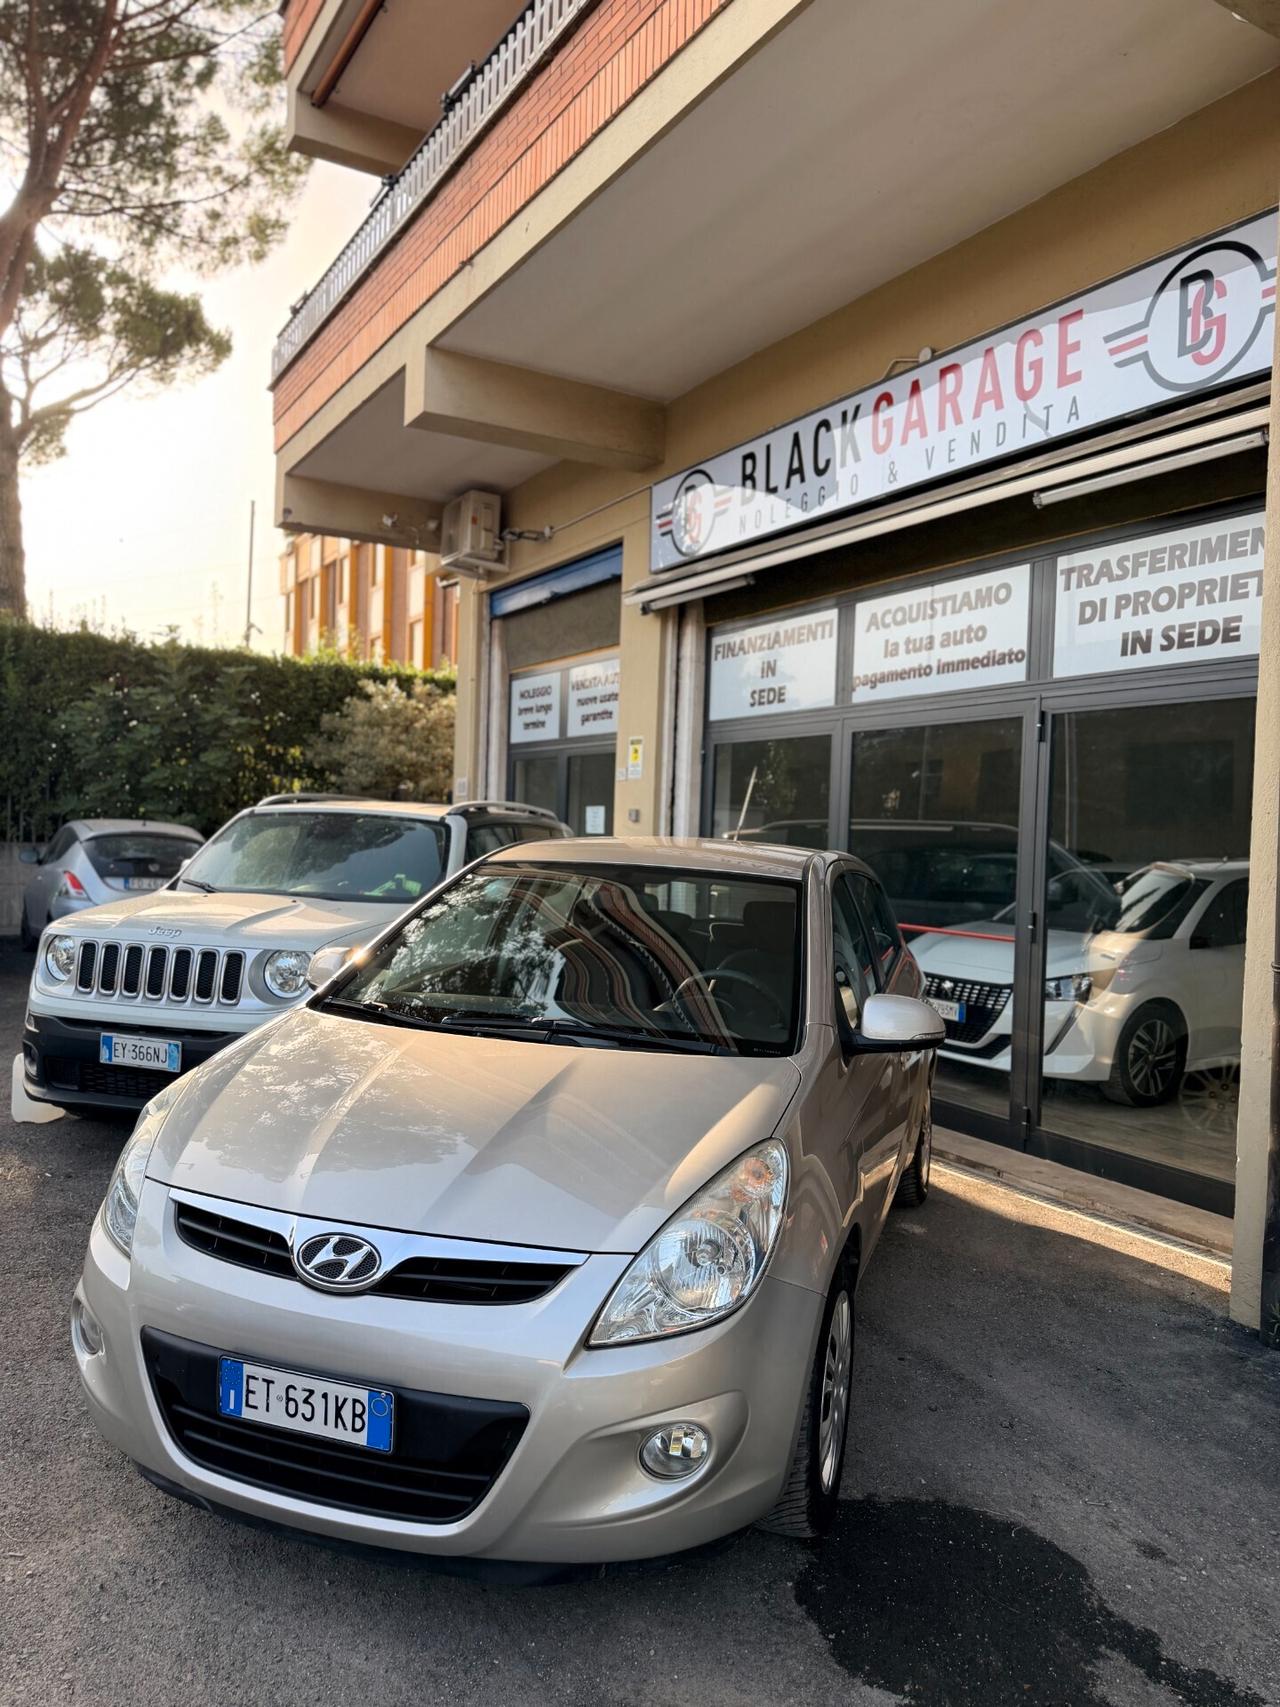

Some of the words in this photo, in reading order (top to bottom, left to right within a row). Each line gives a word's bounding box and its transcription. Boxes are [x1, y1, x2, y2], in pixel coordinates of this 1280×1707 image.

[738, 473, 860, 535] NOLEGGIO
[887, 460, 899, 484] &
[924, 395, 1080, 471] VENDITA
[865, 582, 1012, 633] ACQUISTIAMO
[1077, 597, 1107, 626] DI
[714, 618, 834, 662] FINANZIAMENTI
[883, 638, 899, 659] la
[903, 633, 935, 656] tua
[939, 623, 988, 649] auto
[1120, 628, 1153, 658] IN
[1159, 615, 1243, 652] SEDE
[852, 662, 933, 692] pagamento
[936, 647, 1026, 676] immediato
[749, 686, 786, 708] SEDE
[148, 926, 183, 938] Jeep
